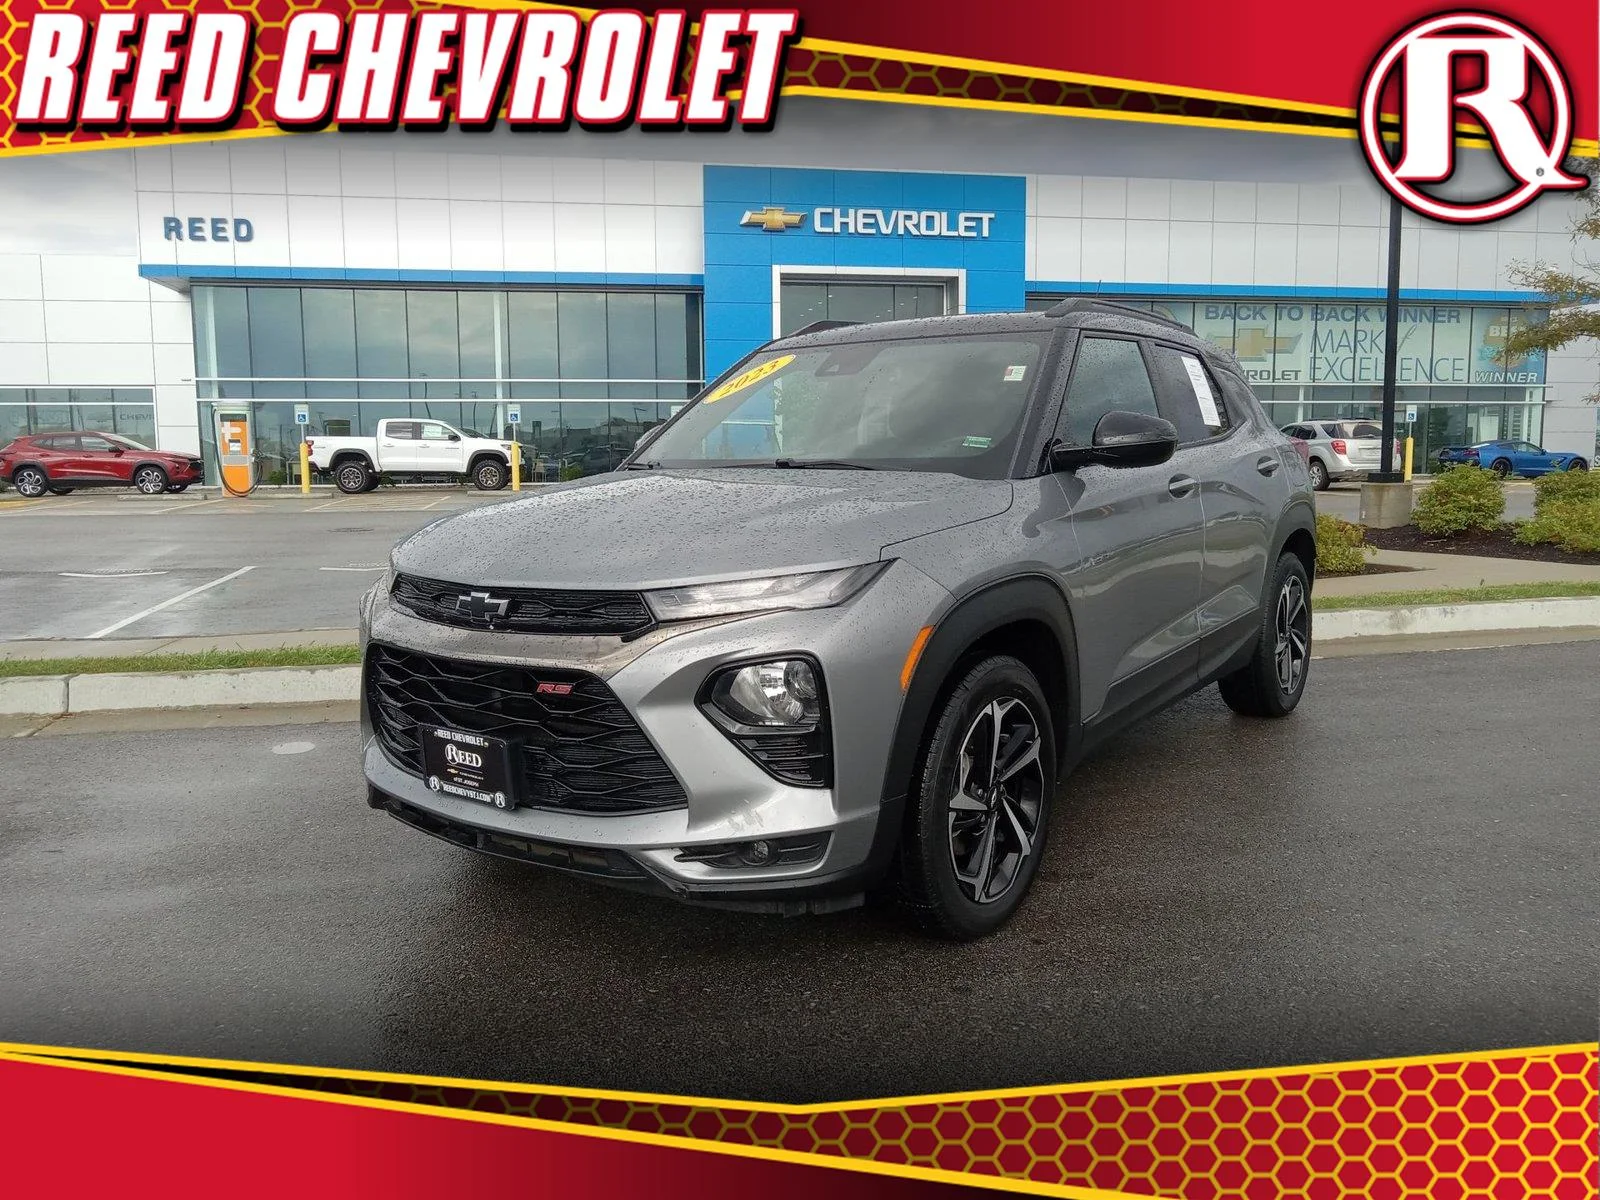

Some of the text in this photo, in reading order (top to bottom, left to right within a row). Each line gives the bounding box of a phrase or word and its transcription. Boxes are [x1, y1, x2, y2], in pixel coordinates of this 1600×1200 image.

[162, 216, 254, 242] REED
[813, 207, 995, 238] CHEVROLET
[1205, 305, 1266, 320] BACK
[1273, 306, 1303, 321] TO
[1311, 307, 1370, 321] BACK
[1310, 329, 1384, 353] MARK
[1309, 356, 1465, 382] EXCELENCE
[1475, 371, 1538, 383] WINNER
[536, 683, 574, 696] RS
[437, 729, 484, 746] REED CHEVROLET
